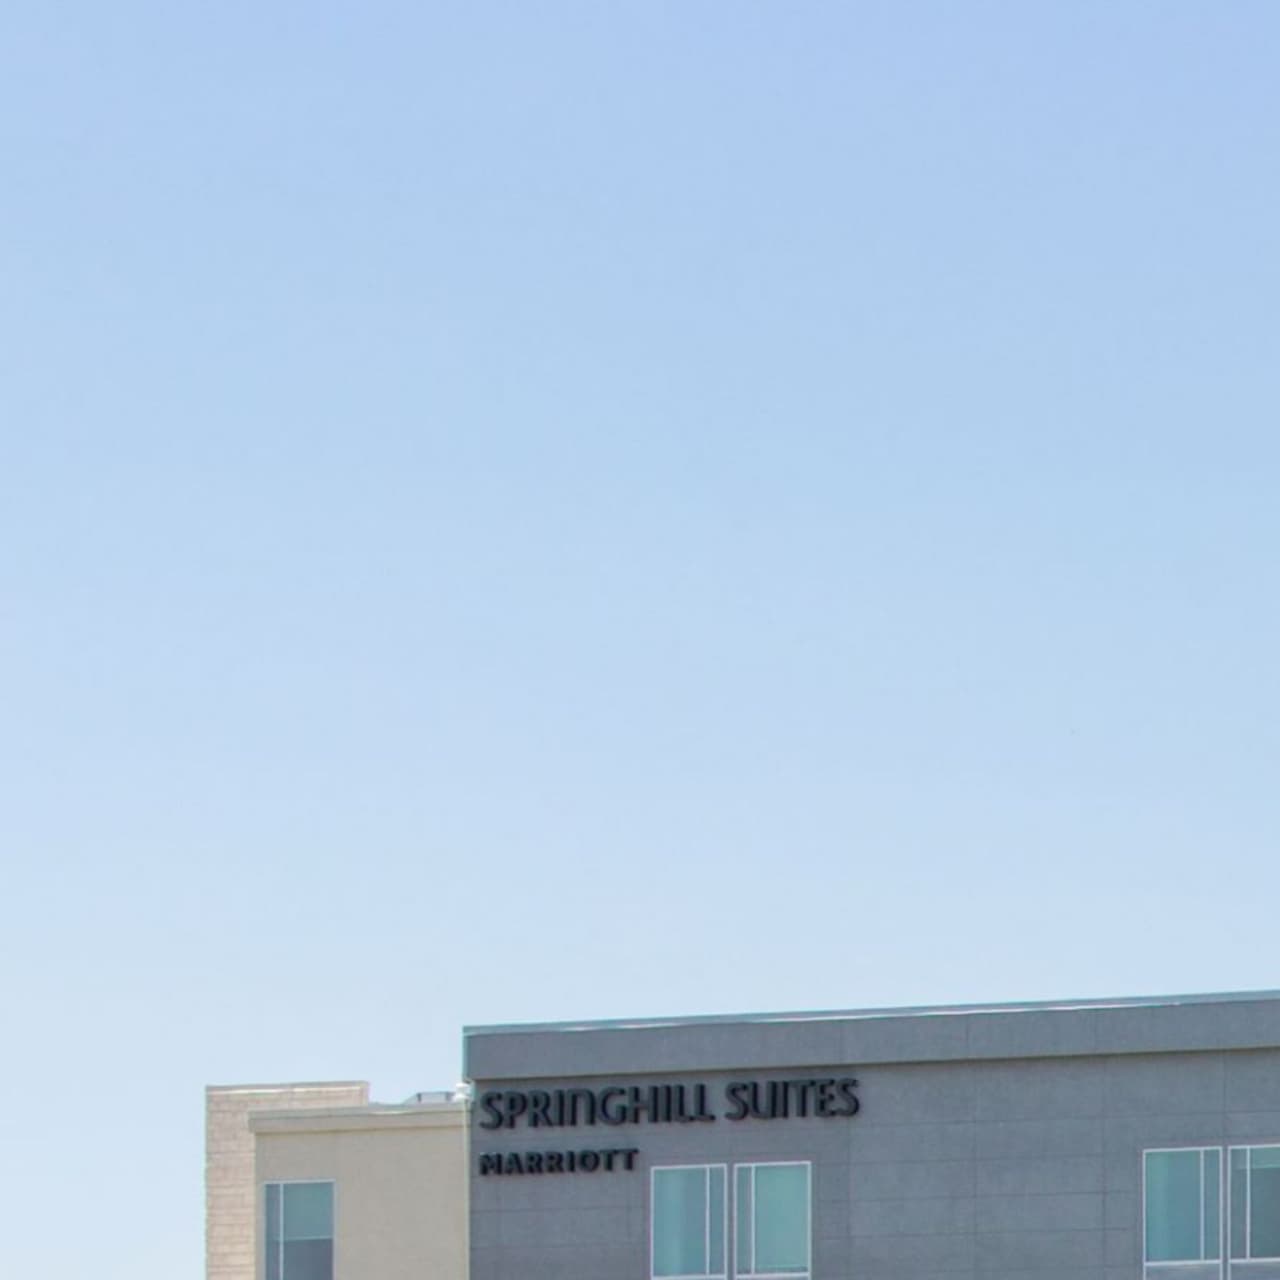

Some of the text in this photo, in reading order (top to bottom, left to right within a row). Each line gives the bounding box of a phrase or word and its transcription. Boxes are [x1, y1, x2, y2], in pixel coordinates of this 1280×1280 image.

[479, 1078, 861, 1130] SPRINGHILL SUITES
[479, 1148, 640, 1176] MARRIOTT
